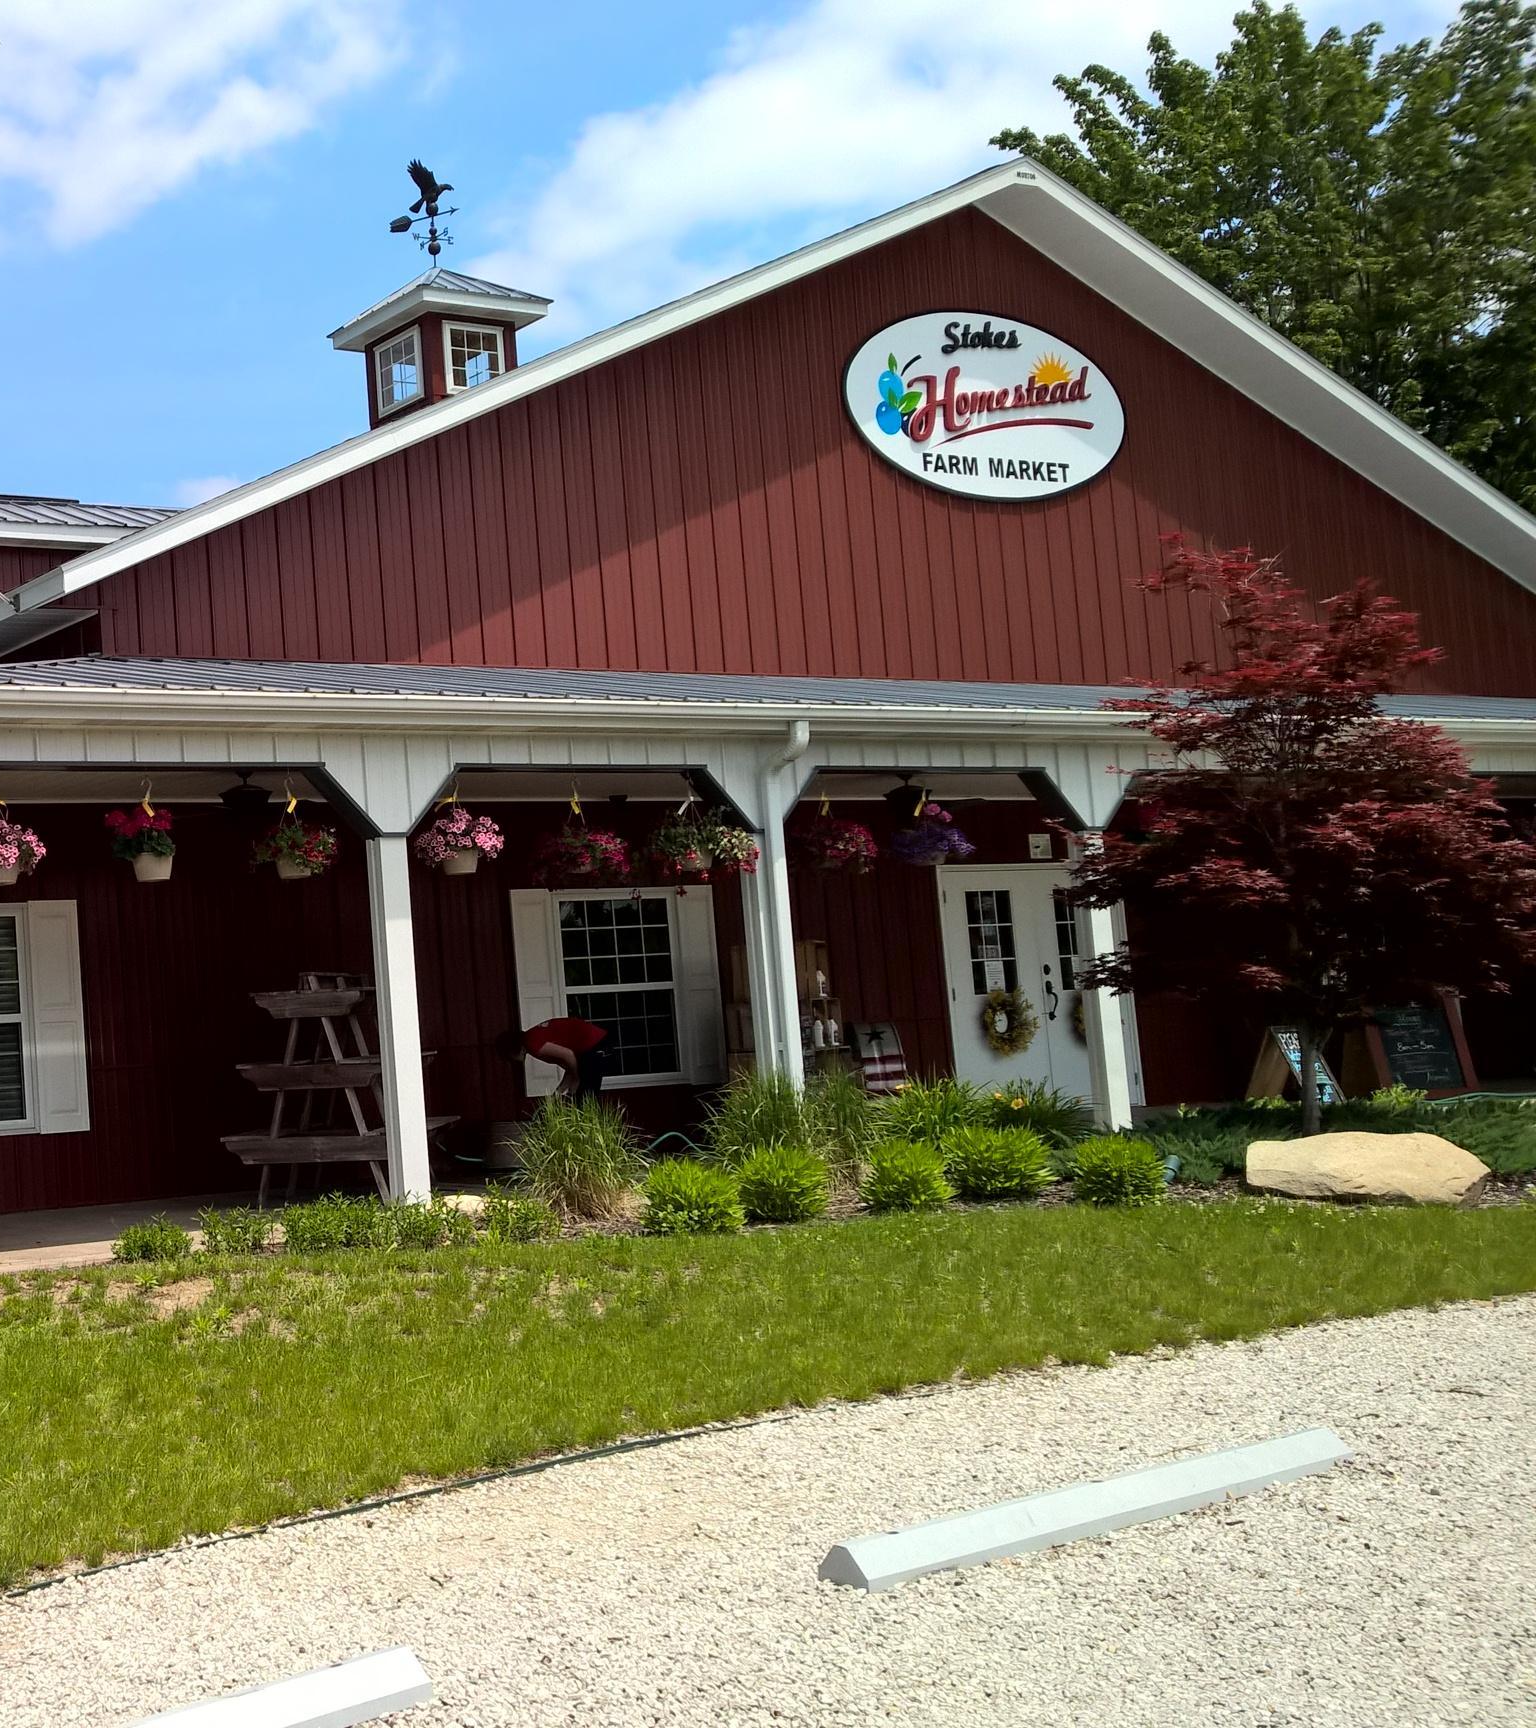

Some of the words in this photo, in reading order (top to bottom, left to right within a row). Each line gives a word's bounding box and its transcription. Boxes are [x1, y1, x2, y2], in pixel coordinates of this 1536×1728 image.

[447, 236, 454, 245] E
[941, 321, 1022, 354] Stokes
[907, 365, 1092, 442] Homestead
[922, 452, 979, 476] FARM
[988, 457, 1070, 483] MARKET
